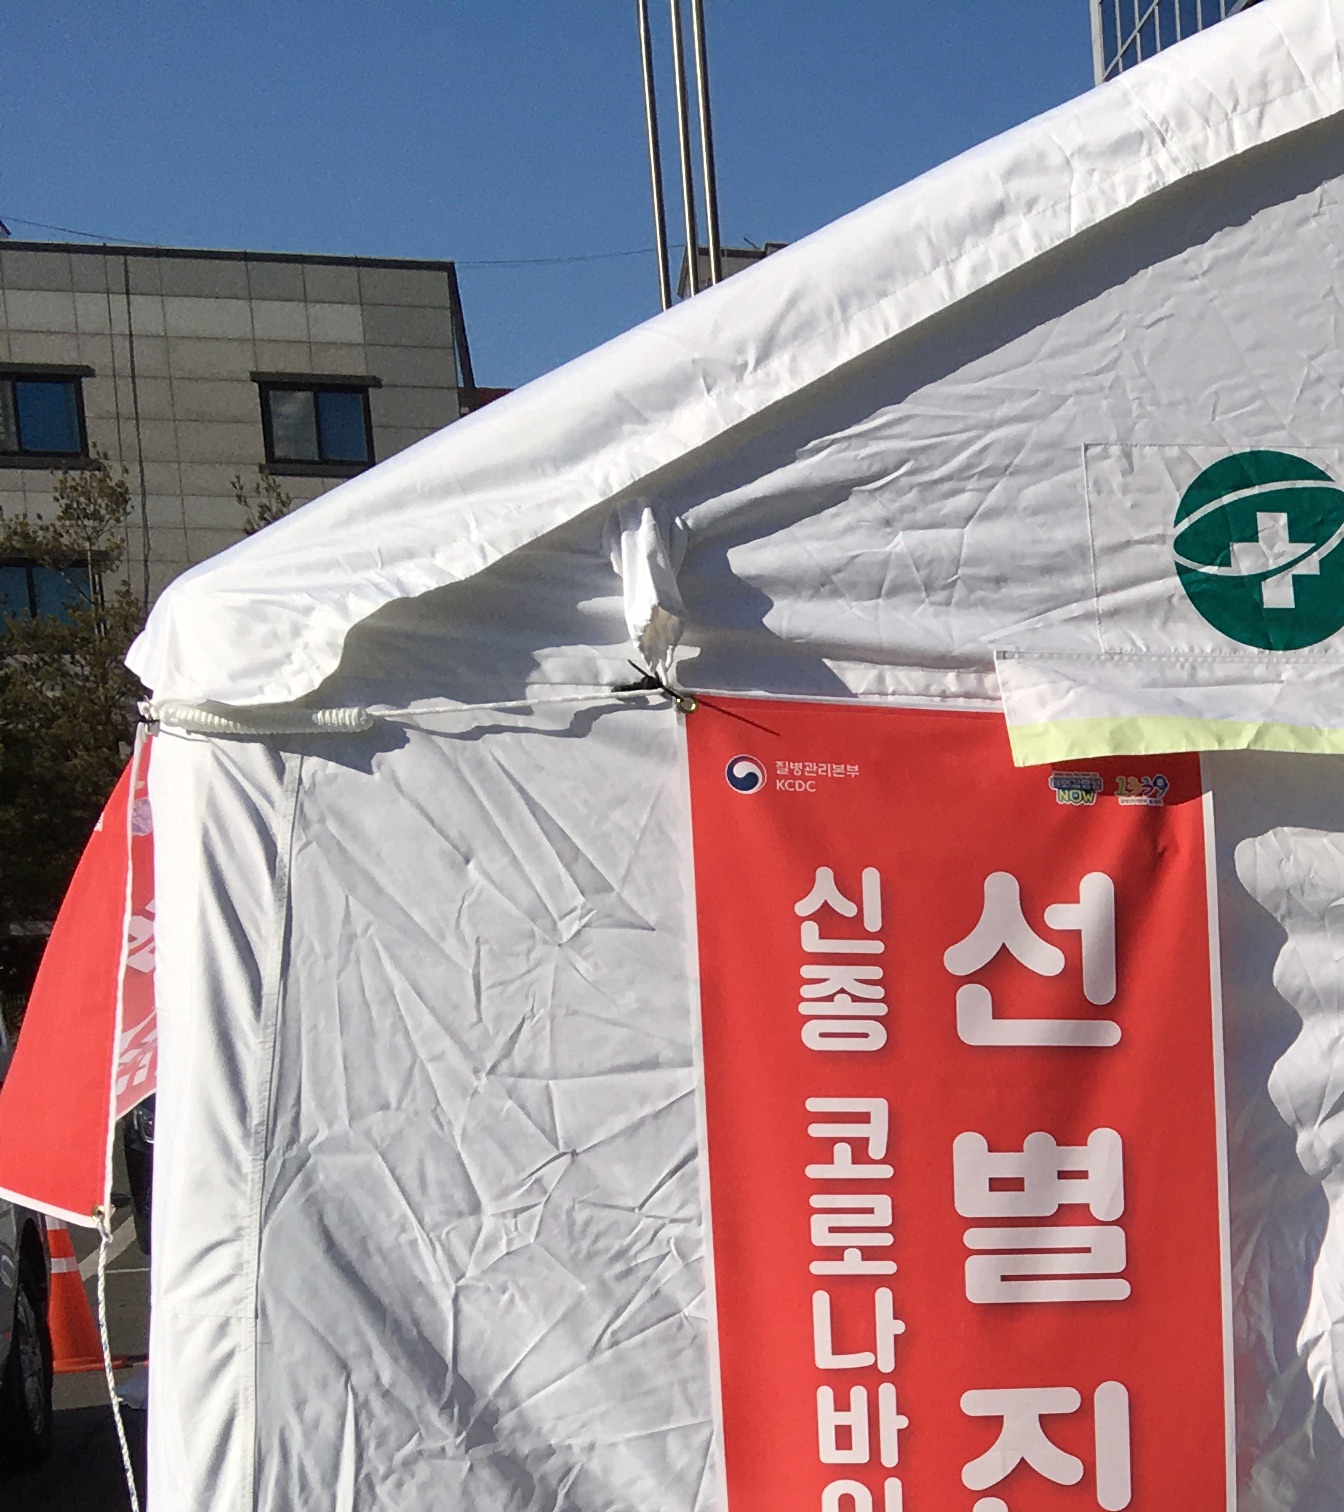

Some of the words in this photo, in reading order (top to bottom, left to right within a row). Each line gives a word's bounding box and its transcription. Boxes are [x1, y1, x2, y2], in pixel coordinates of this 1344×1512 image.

[775, 760, 860, 778] 질병관리본부
[776, 779, 817, 792] KCDC
[1058, 789, 1095, 803] NOW
[794, 866, 889, 1053] 신종
